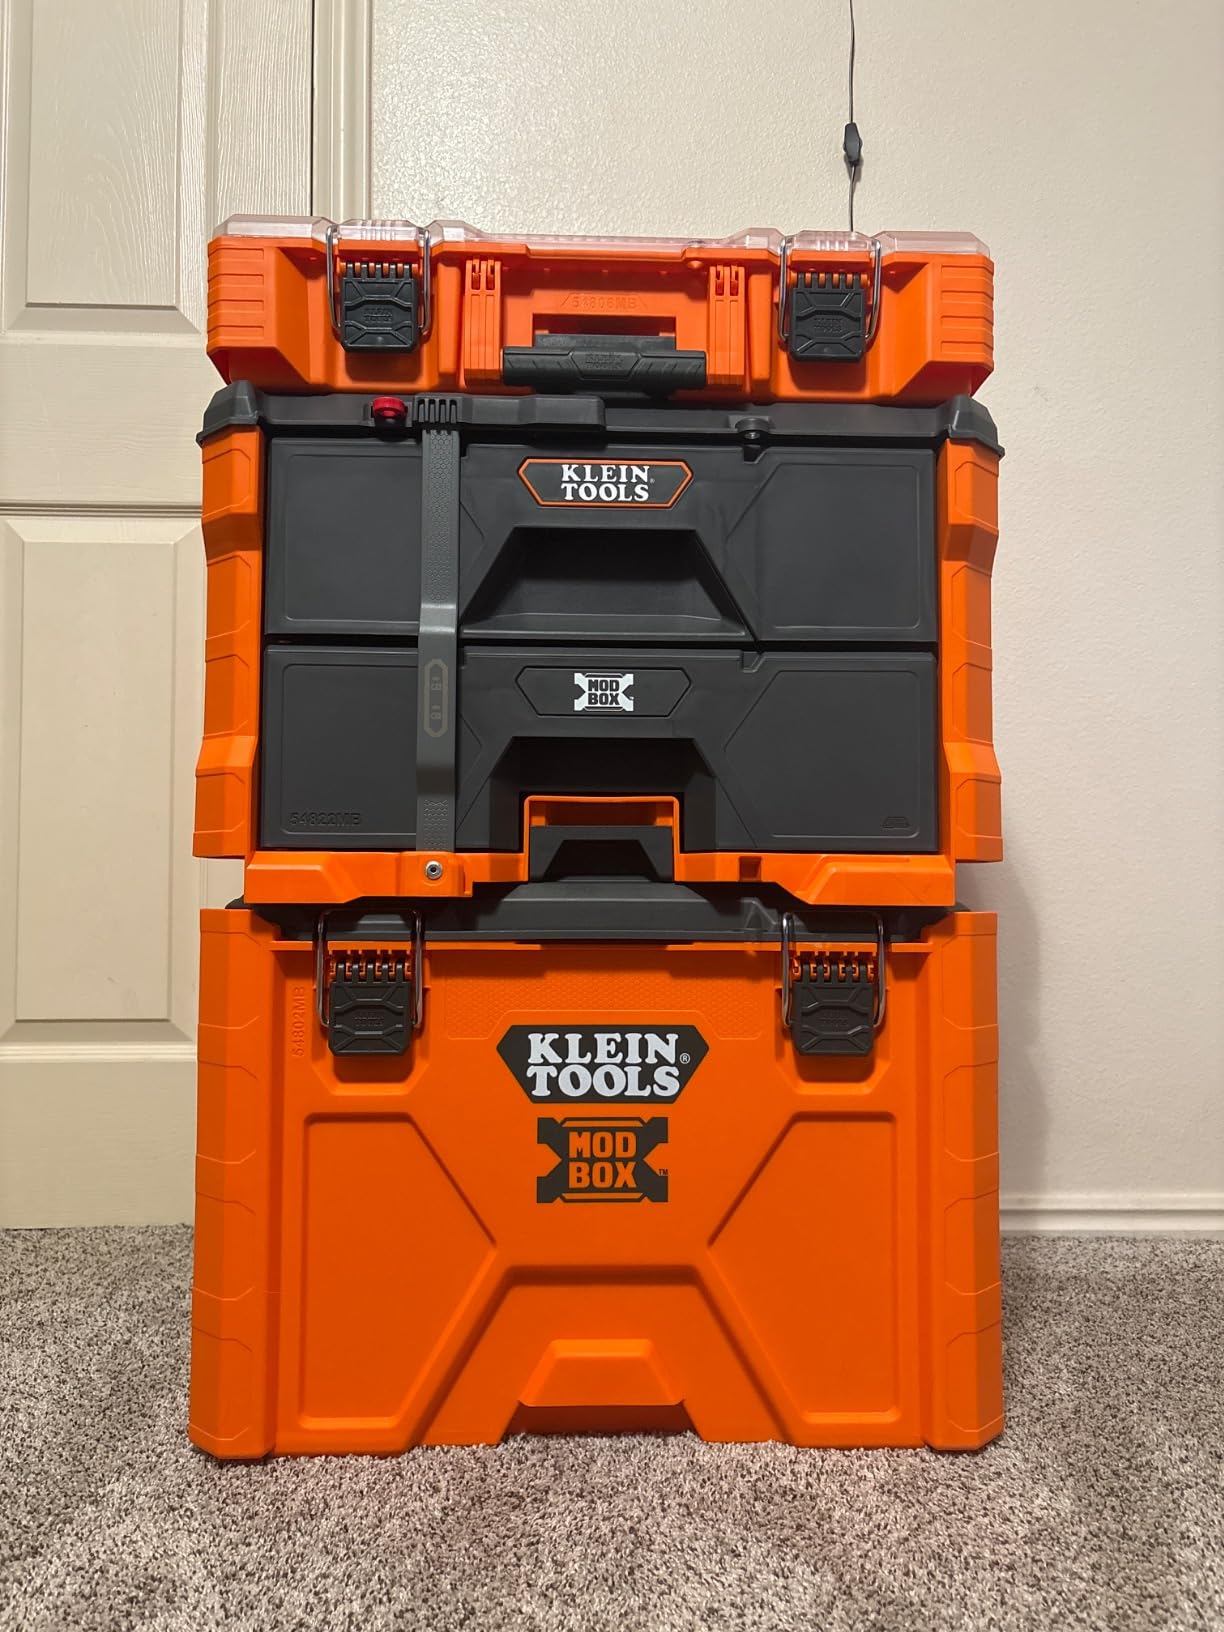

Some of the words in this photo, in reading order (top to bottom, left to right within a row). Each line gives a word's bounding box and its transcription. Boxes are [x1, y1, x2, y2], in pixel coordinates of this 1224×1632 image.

[561, 482, 649, 502] TOOLS
[587, 679, 620, 692] MOD
[587, 692, 621, 705] BOX
[526, 1064, 680, 1097] TOOLS
[568, 1131, 637, 1158] MOD
[568, 1161, 637, 1188] BOX
